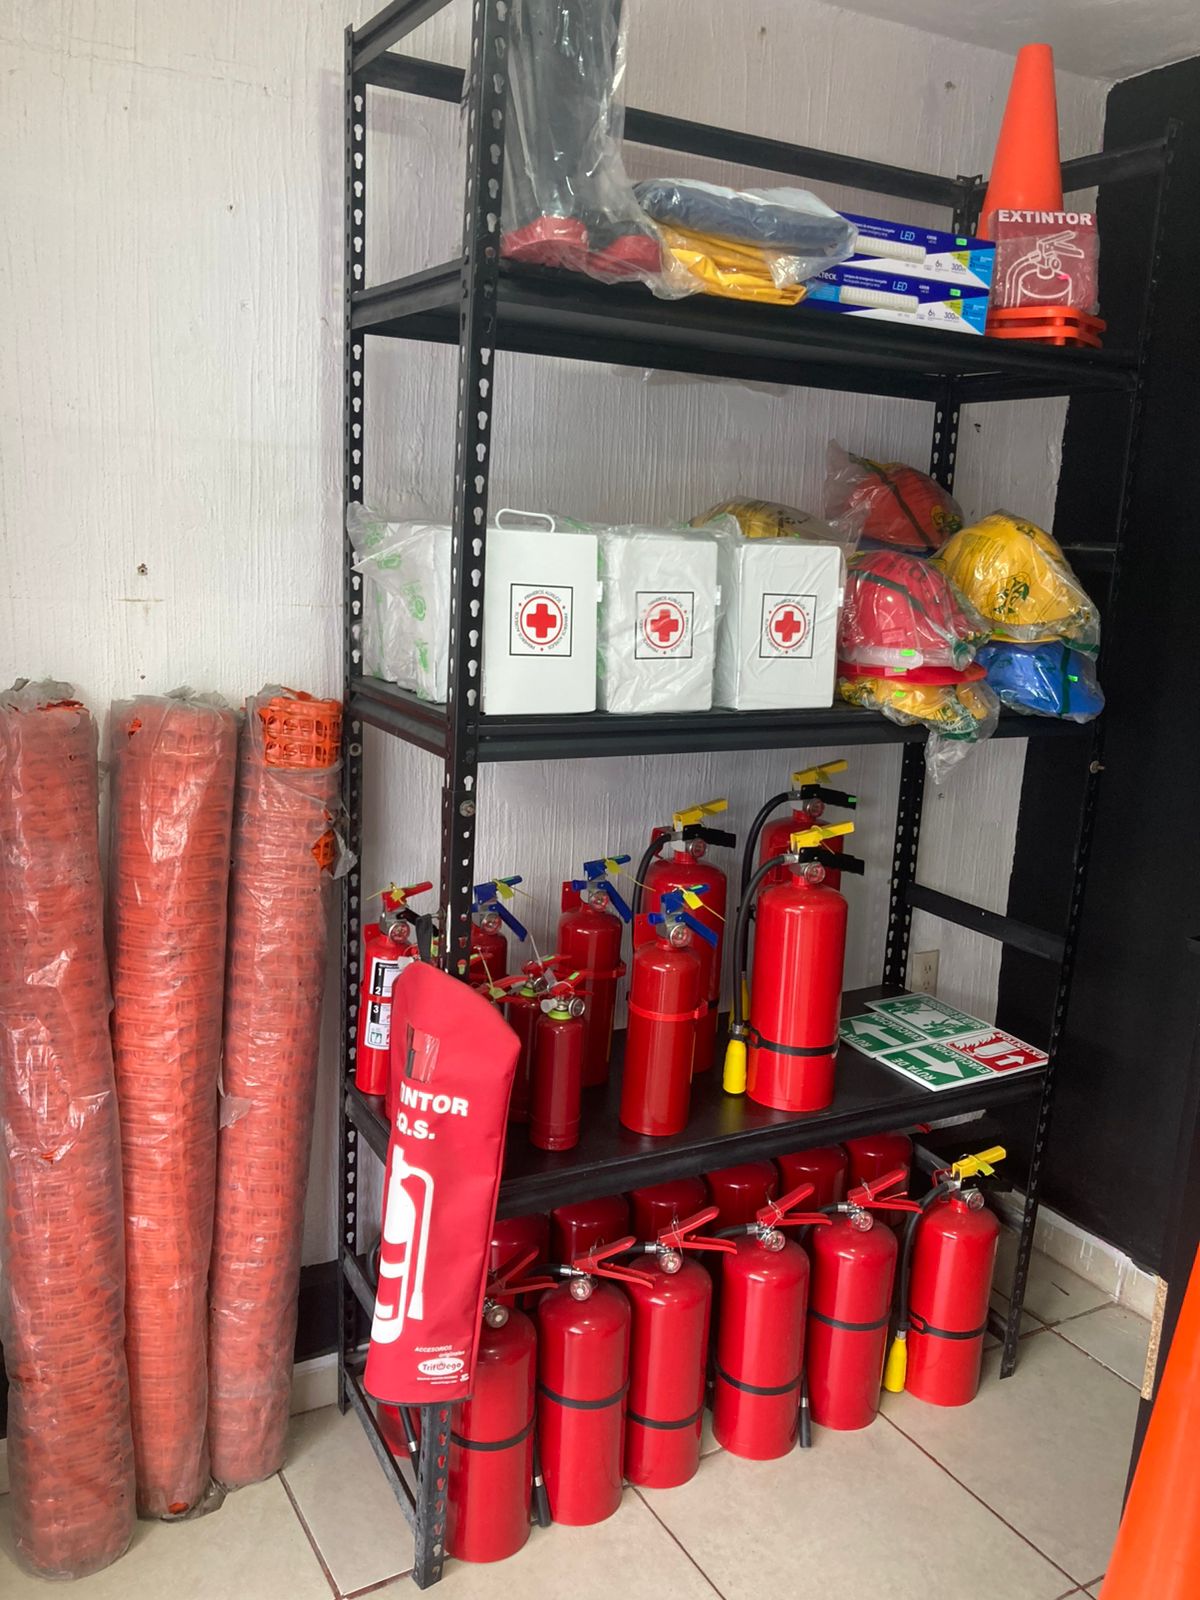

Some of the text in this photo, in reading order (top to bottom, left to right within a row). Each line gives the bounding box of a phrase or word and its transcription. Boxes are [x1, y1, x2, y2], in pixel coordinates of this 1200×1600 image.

[998, 209, 1093, 226] EXTINTOR
[899, 230, 915, 241] LED
[892, 281, 908, 292] LED
[377, 967, 383, 976] 1
[374, 986, 381, 995] 2
[372, 1004, 379, 1014] 3
[844, 1033, 873, 1048] RUTA
[996, 1033, 1046, 1059] EXTINTOR
[929, 1042, 991, 1075] EVACUACION
[891, 1057, 937, 1081] RUTA DE
[400, 1081, 470, 1118] INTOR
